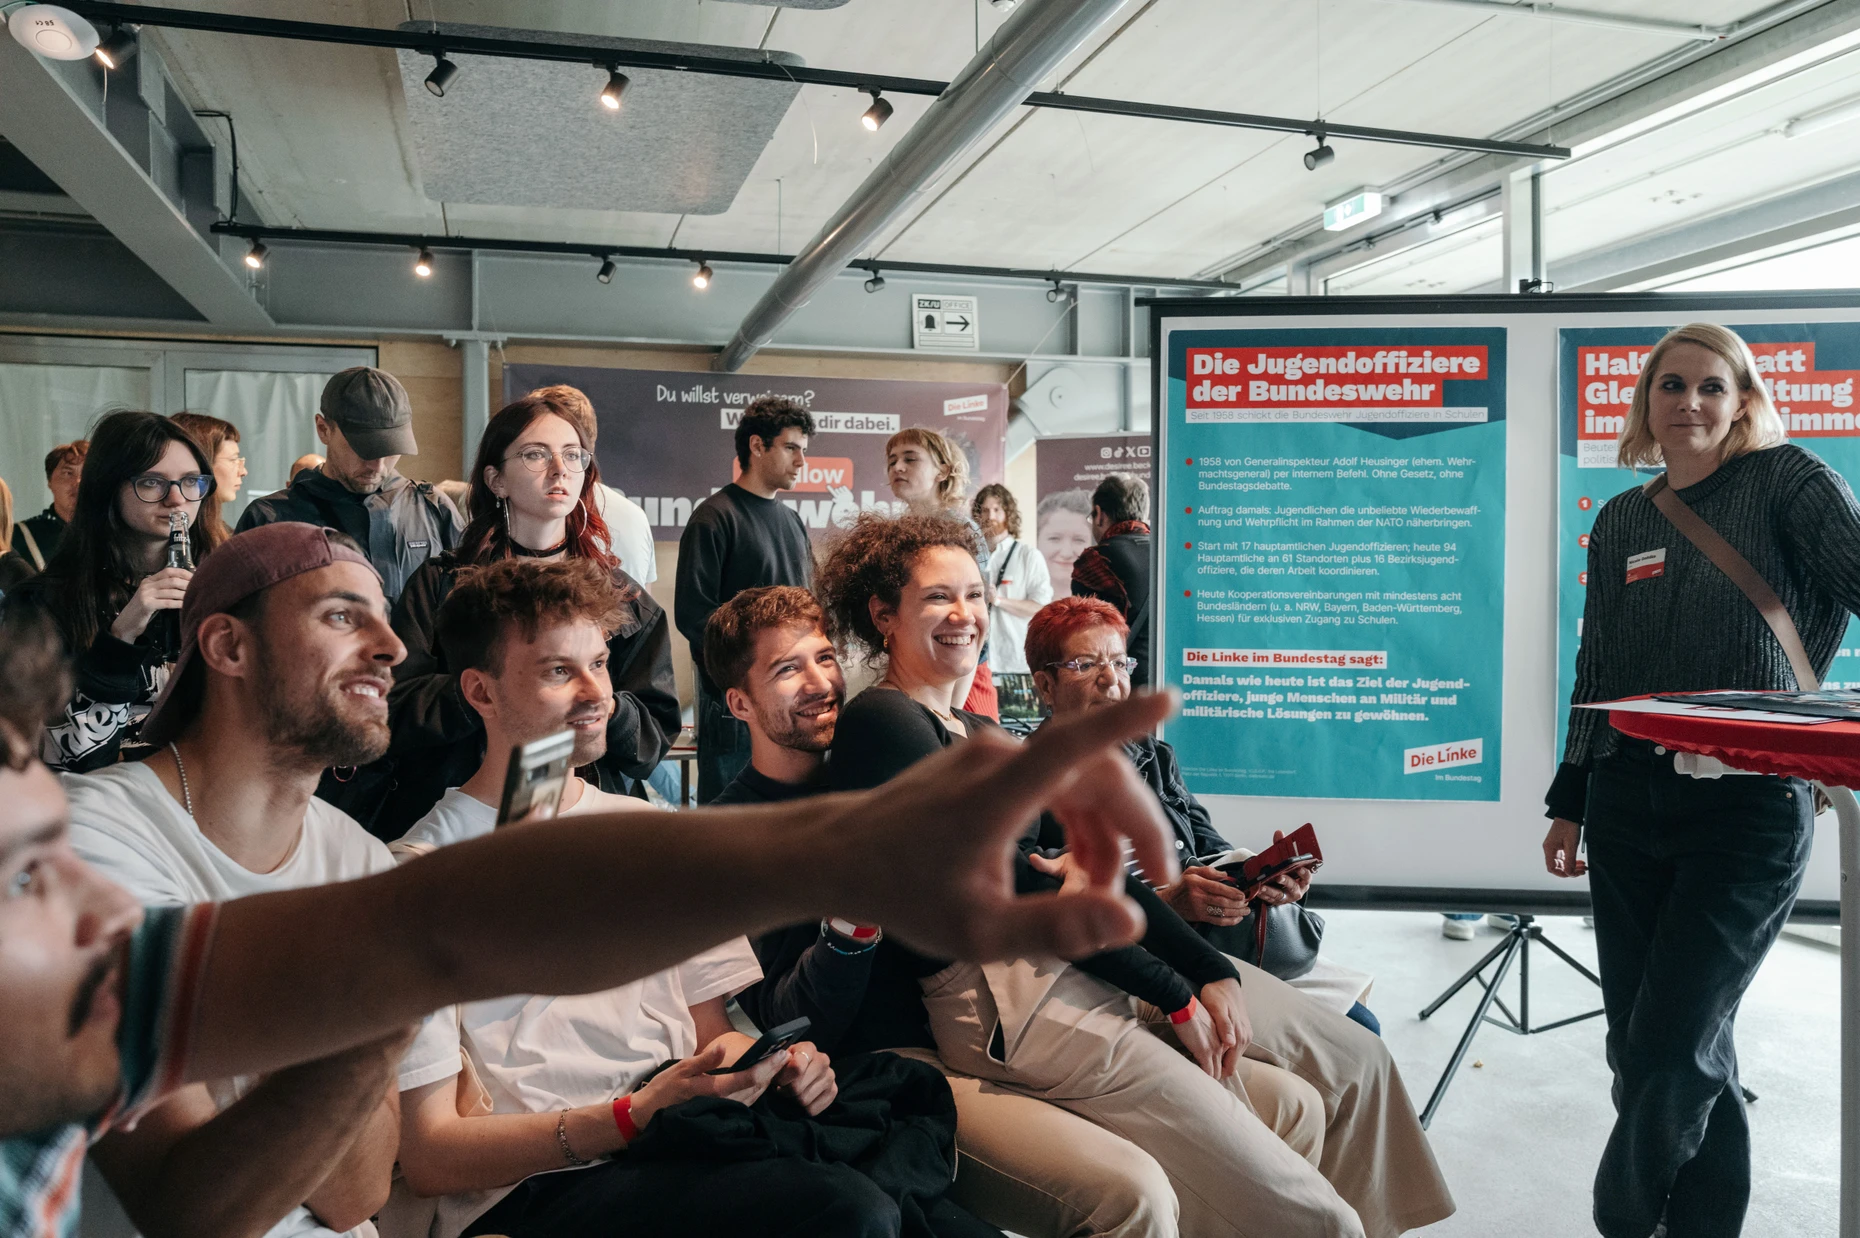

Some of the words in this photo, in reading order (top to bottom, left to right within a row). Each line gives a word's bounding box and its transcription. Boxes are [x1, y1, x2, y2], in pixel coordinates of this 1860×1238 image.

[1193, 354, 1240, 375] Die
[1247, 351, 1481, 380] Jugendoffiziere
[657, 385, 676, 402] Du
[681, 384, 719, 403] willst
[1192, 381, 1241, 402] der
[1249, 378, 1435, 402] Bundeswehr
[1191, 411, 1209, 420] Seit
[1213, 411, 1233, 419] 1958
[1237, 411, 1271, 419] schickt
[1275, 410, 1288, 419] die
[1292, 410, 1352, 419] Bundeswehr
[1356, 410, 1430, 420] Jugendoffiziere
[1433, 410, 1441, 419] in
[1445, 410, 1485, 419] Schulen
[818, 415, 841, 429] dir
[844, 416, 895, 431] dabei.
[1199, 458, 1221, 466] 1958
[1244, 457, 1330, 467] Generalinspekteur
[1333, 457, 1358, 466] Adolf
[1361, 457, 1408, 467] Heusinger
[1412, 457, 1444, 467] (ehem.
[1447, 457, 1476, 466] Wehr-
[1199, 470, 1270, 480] machtsgeneral)
[1274, 471, 1288, 480] per
[1292, 470, 1333, 478] internem
[1336, 469, 1369, 478] Befehl.
[1372, 469, 1397, 478] Ohne
[1400, 469, 1436, 479] Gesetz,
[1440, 470, 1464, 478] ohne
[1199, 482, 1292, 492] Bundestagsdebatte.
[1198, 506, 1232, 516] Auftrag
[1236, 506, 1271, 514] damals:
[1275, 506, 1337, 516] Jugendlichen
[1340, 506, 1355, 515] die
[1358, 506, 1407, 515] unbeliebte
[1411, 506, 1481, 515] Wiederbewaff-
[1198, 520, 1221, 528] nung
[1225, 518, 1242, 526] und
[1245, 518, 1298, 528] Wehrpflicht
[1301, 518, 1312, 526] im
[1316, 518, 1354, 527] Rahmen
[1357, 518, 1373, 527] der
[1376, 518, 1403, 527] NATO
[1406, 518, 1472, 529] näherbringen.
[1198, 542, 1220, 551] Start
[1224, 542, 1238, 551] mit
[1241, 542, 1250, 551] 17
[1254, 542, 1326, 552] hauptamtlichen
[1329, 542, 1411, 552] Jugendoffizieren;
[1414, 543, 1441, 551] heute
[1444, 543, 1456, 551] 94
[1197, 554, 1265, 564] Hauptamtliche
[1282, 554, 1292, 562] 61
[1296, 555, 1348, 563] Standorten
[1351, 555, 1371, 565] plus
[1374, 555, 1385, 563] 16
[1388, 555, 1459, 565] Bezirksjugend-
[1197, 566, 1237, 575] offiziere,
[1240, 566, 1254, 575] die
[1258, 566, 1284, 575] deren
[1288, 566, 1316, 575] Arbeit
[1318, 567, 1379, 575] koordinieren.
[1197, 590, 1225, 598] Heute
[1228, 590, 1363, 601] Kooperationsvereinbarungen
[1366, 591, 1380, 599] mit
[1383, 592, 1437, 600] mindestens
[1441, 592, 1461, 600] acht
[1197, 602, 1266, 611] Bundesländern
[1270, 602, 1281, 612] (u.
[1296, 603, 1321, 612] NRW,
[1324, 604, 1359, 613] Bayern,
[1363, 604, 1462, 614] Baden-Württemberg,
[1197, 614, 1234, 623] Hessen)
[1238, 614, 1251, 623] für
[1254, 614, 1302, 623] exklusiven
[1305, 615, 1340, 625] Zugang
[1358, 615, 1398, 624] Schulen.
[1187, 652, 1208, 662] Die
[1212, 652, 1249, 662] Linke
[1252, 652, 1269, 663] im
[1273, 653, 1346, 666] Bundestag
[1349, 655, 1383, 666] sagt:
[1183, 674, 1233, 685] Damals
[1236, 675, 1262, 686] wie
[1265, 675, 1304, 686] heute
[1307, 676, 1326, 687] ist
[1328, 676, 1353, 688] das
[1356, 677, 1382, 688] Ziel
[1386, 677, 1409, 688] der
[1412, 678, 1470, 691] Jugend-
[1182, 690, 1244, 703] offiziere,
[1245, 691, 1284, 705] junge
[1287, 692, 1357, 704] Menschen
[1360, 695, 1377, 704] an
[1380, 693, 1428, 705] Militär
[1431, 694, 1457, 705] und
[1182, 706, 1264, 718] militärische
[1267, 707, 1332, 722] Lösungen
[1335, 711, 1351, 720] zu
[1354, 709, 1429, 723] gewöhnen.
[1411, 753, 1434, 767] Die
[1437, 746, 1477, 763] Linke
[1445, 774, 1482, 783] Bundestag
